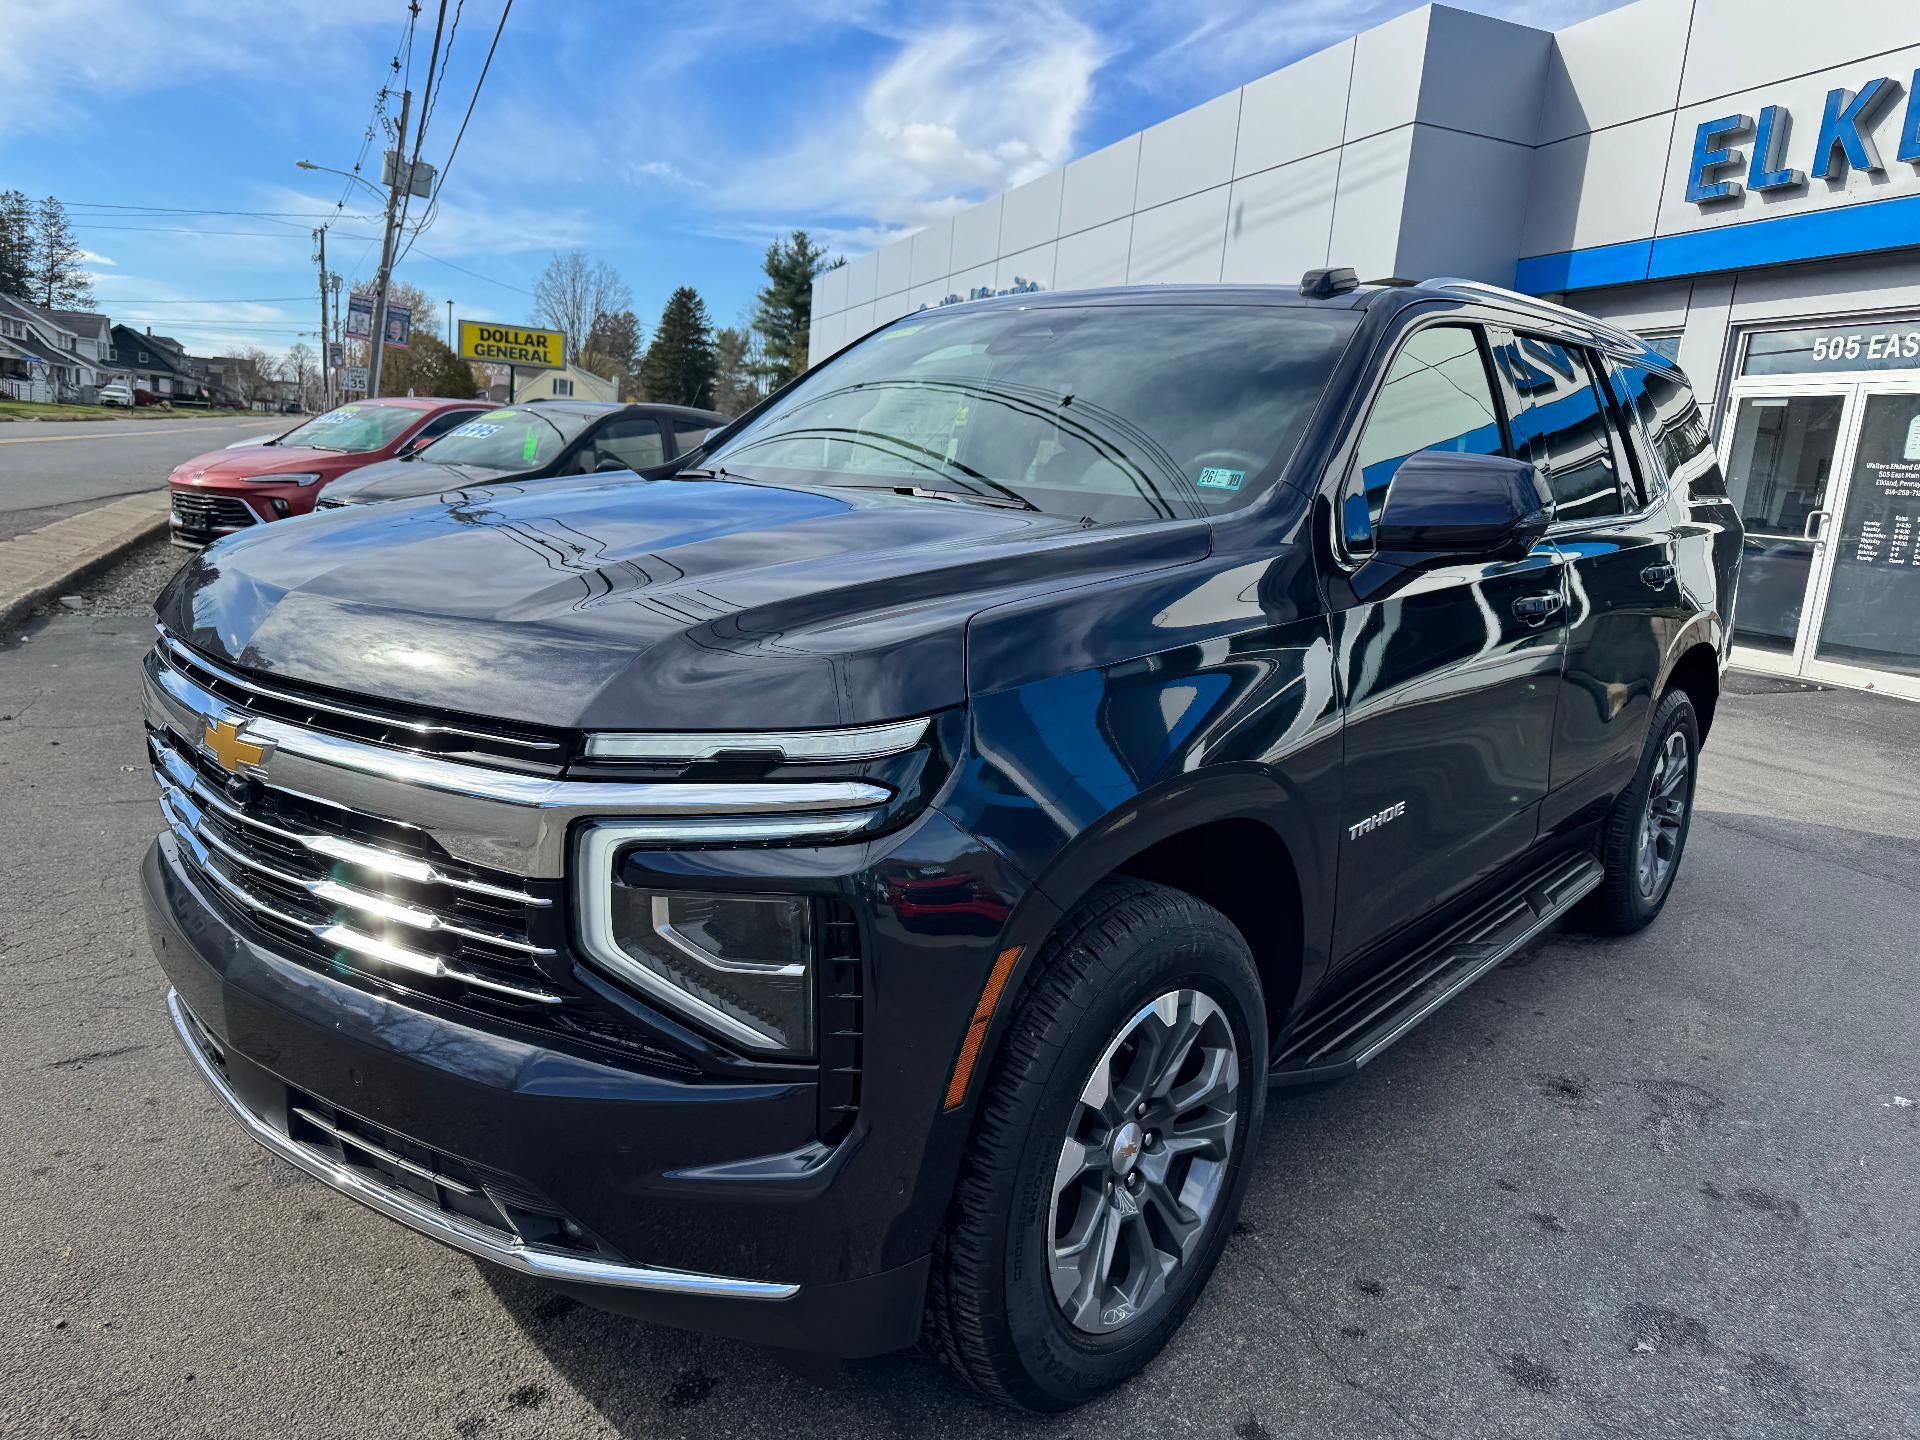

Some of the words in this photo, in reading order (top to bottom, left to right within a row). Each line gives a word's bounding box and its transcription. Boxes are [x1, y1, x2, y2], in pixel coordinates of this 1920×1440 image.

[479, 328, 548, 348] DOLLAR
[474, 343, 553, 364] GENERAL
[1812, 335, 1862, 361] 505
[1867, 332, 1920, 359] EAS
[350, 378, 366, 389] 35
[1890, 463, 1914, 471] Elkland
[1202, 469, 1215, 483] 26
[1891, 471, 1904, 479] East
[1876, 479, 1899, 488] Elkland,
[1348, 800, 1406, 841] TAHOE
